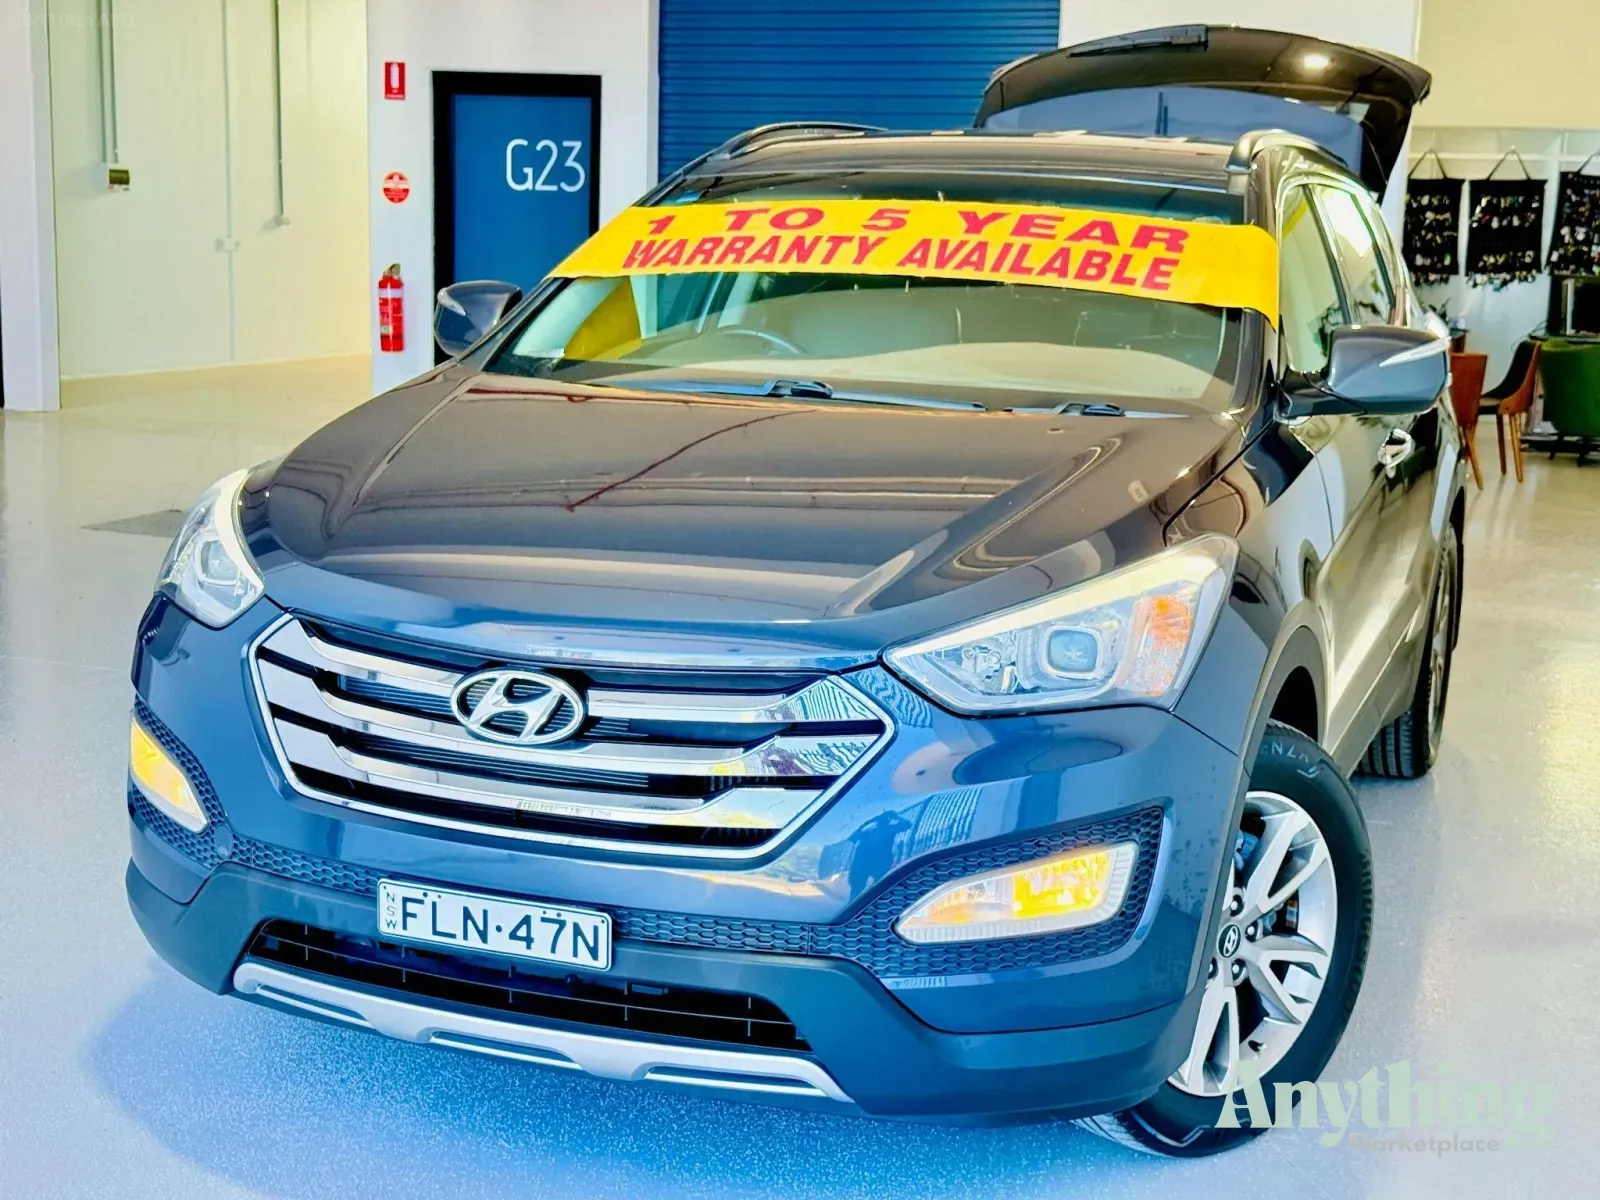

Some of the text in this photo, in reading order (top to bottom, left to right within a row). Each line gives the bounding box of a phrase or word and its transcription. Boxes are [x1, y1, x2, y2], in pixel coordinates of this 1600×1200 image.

[506, 139, 585, 192] G23
[648, 207, 1189, 253] 1 TO 5 YEAR
[621, 235, 1180, 291] WARRANTY AVAILABLE
[385, 892, 398, 930] NSW
